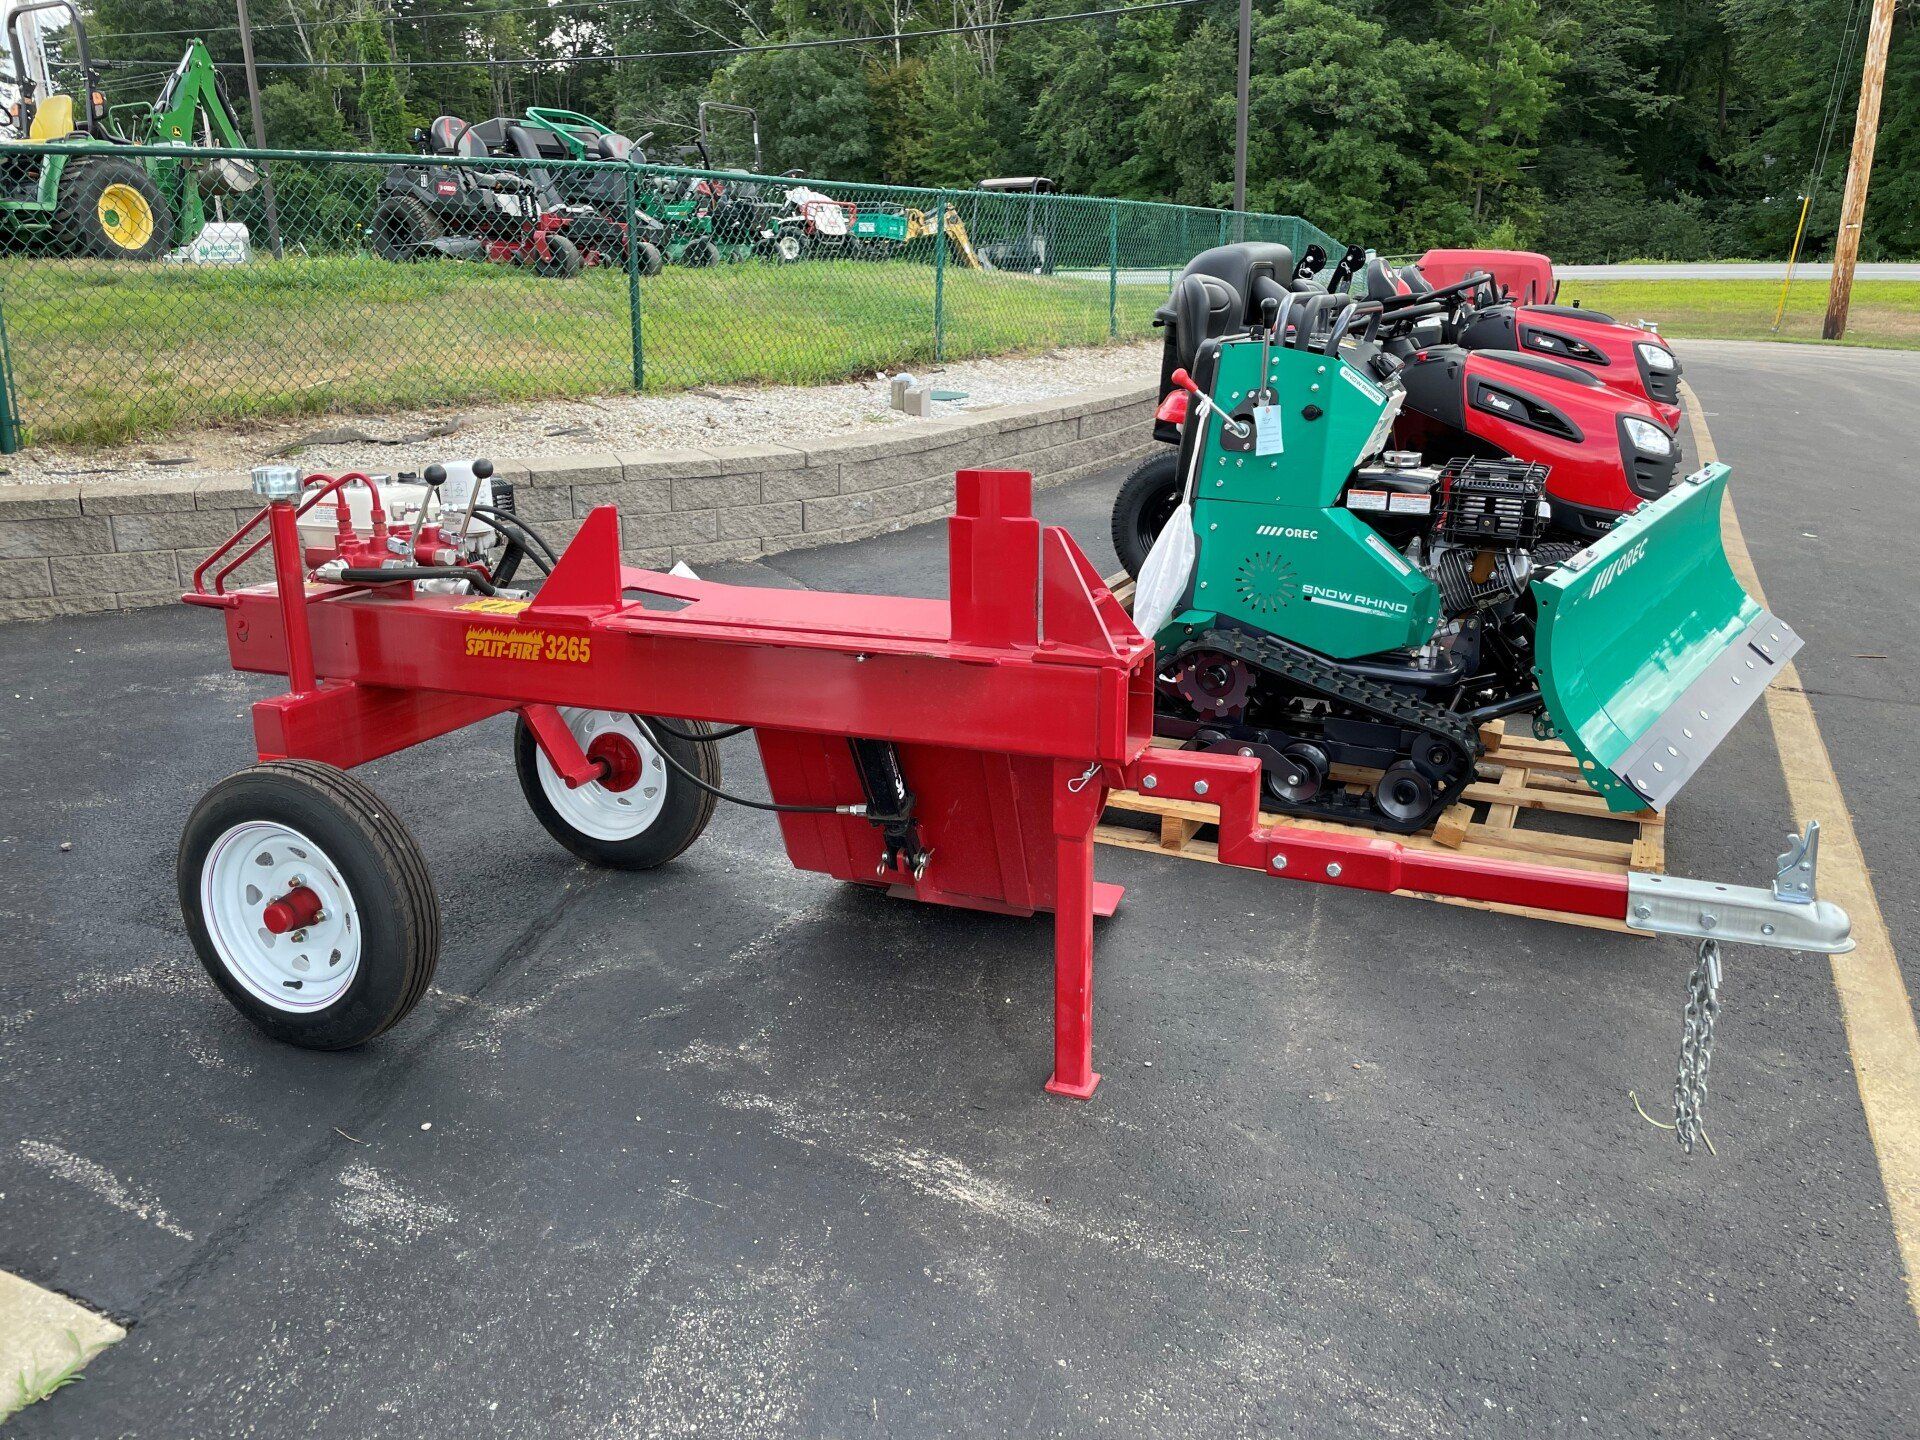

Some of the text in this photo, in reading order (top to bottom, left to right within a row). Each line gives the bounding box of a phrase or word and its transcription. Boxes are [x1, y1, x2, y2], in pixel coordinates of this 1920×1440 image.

[1343, 369, 1381, 402] SNOW RHINO
[1285, 528, 1319, 540] OREC
[1617, 537, 1649, 577] OREC
[1302, 584, 1408, 613] SNOW RHINO
[465, 634, 591, 663] SPLIT-FIRE 3265
